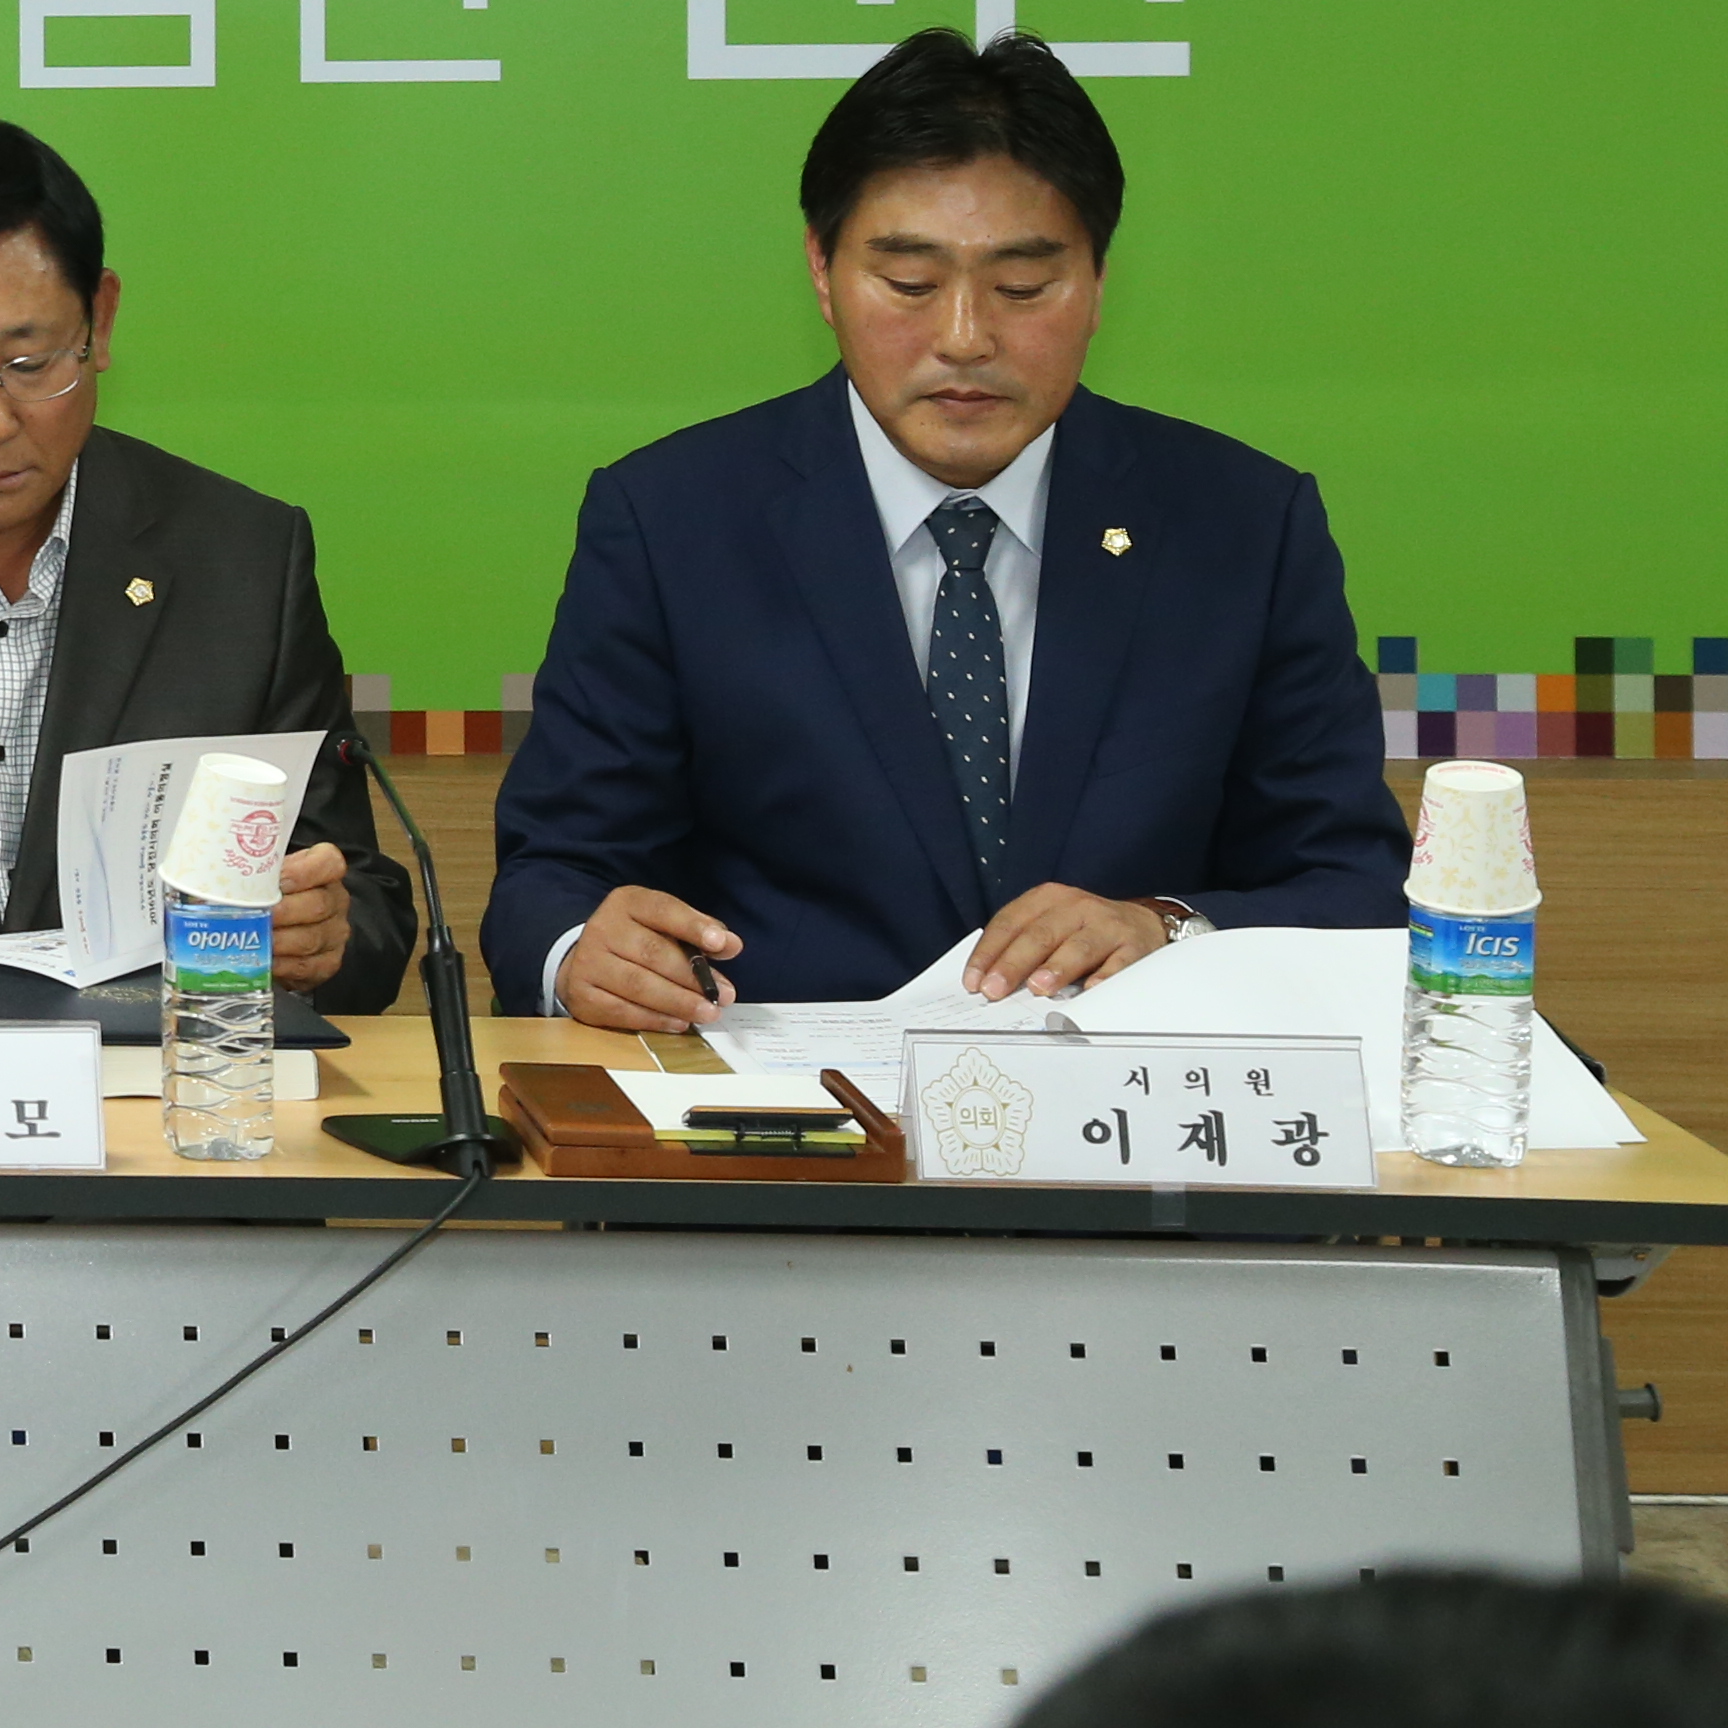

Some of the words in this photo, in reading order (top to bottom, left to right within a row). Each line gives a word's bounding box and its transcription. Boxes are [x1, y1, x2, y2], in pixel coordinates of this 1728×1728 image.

[188, 931, 261, 951] 아이시스
[1465, 932, 1521, 958] ICIS
[1123, 1066, 1275, 1097] 시의원
[959, 1106, 1000, 1132] 의회
[1082, 1107, 1330, 1168] 이재광
